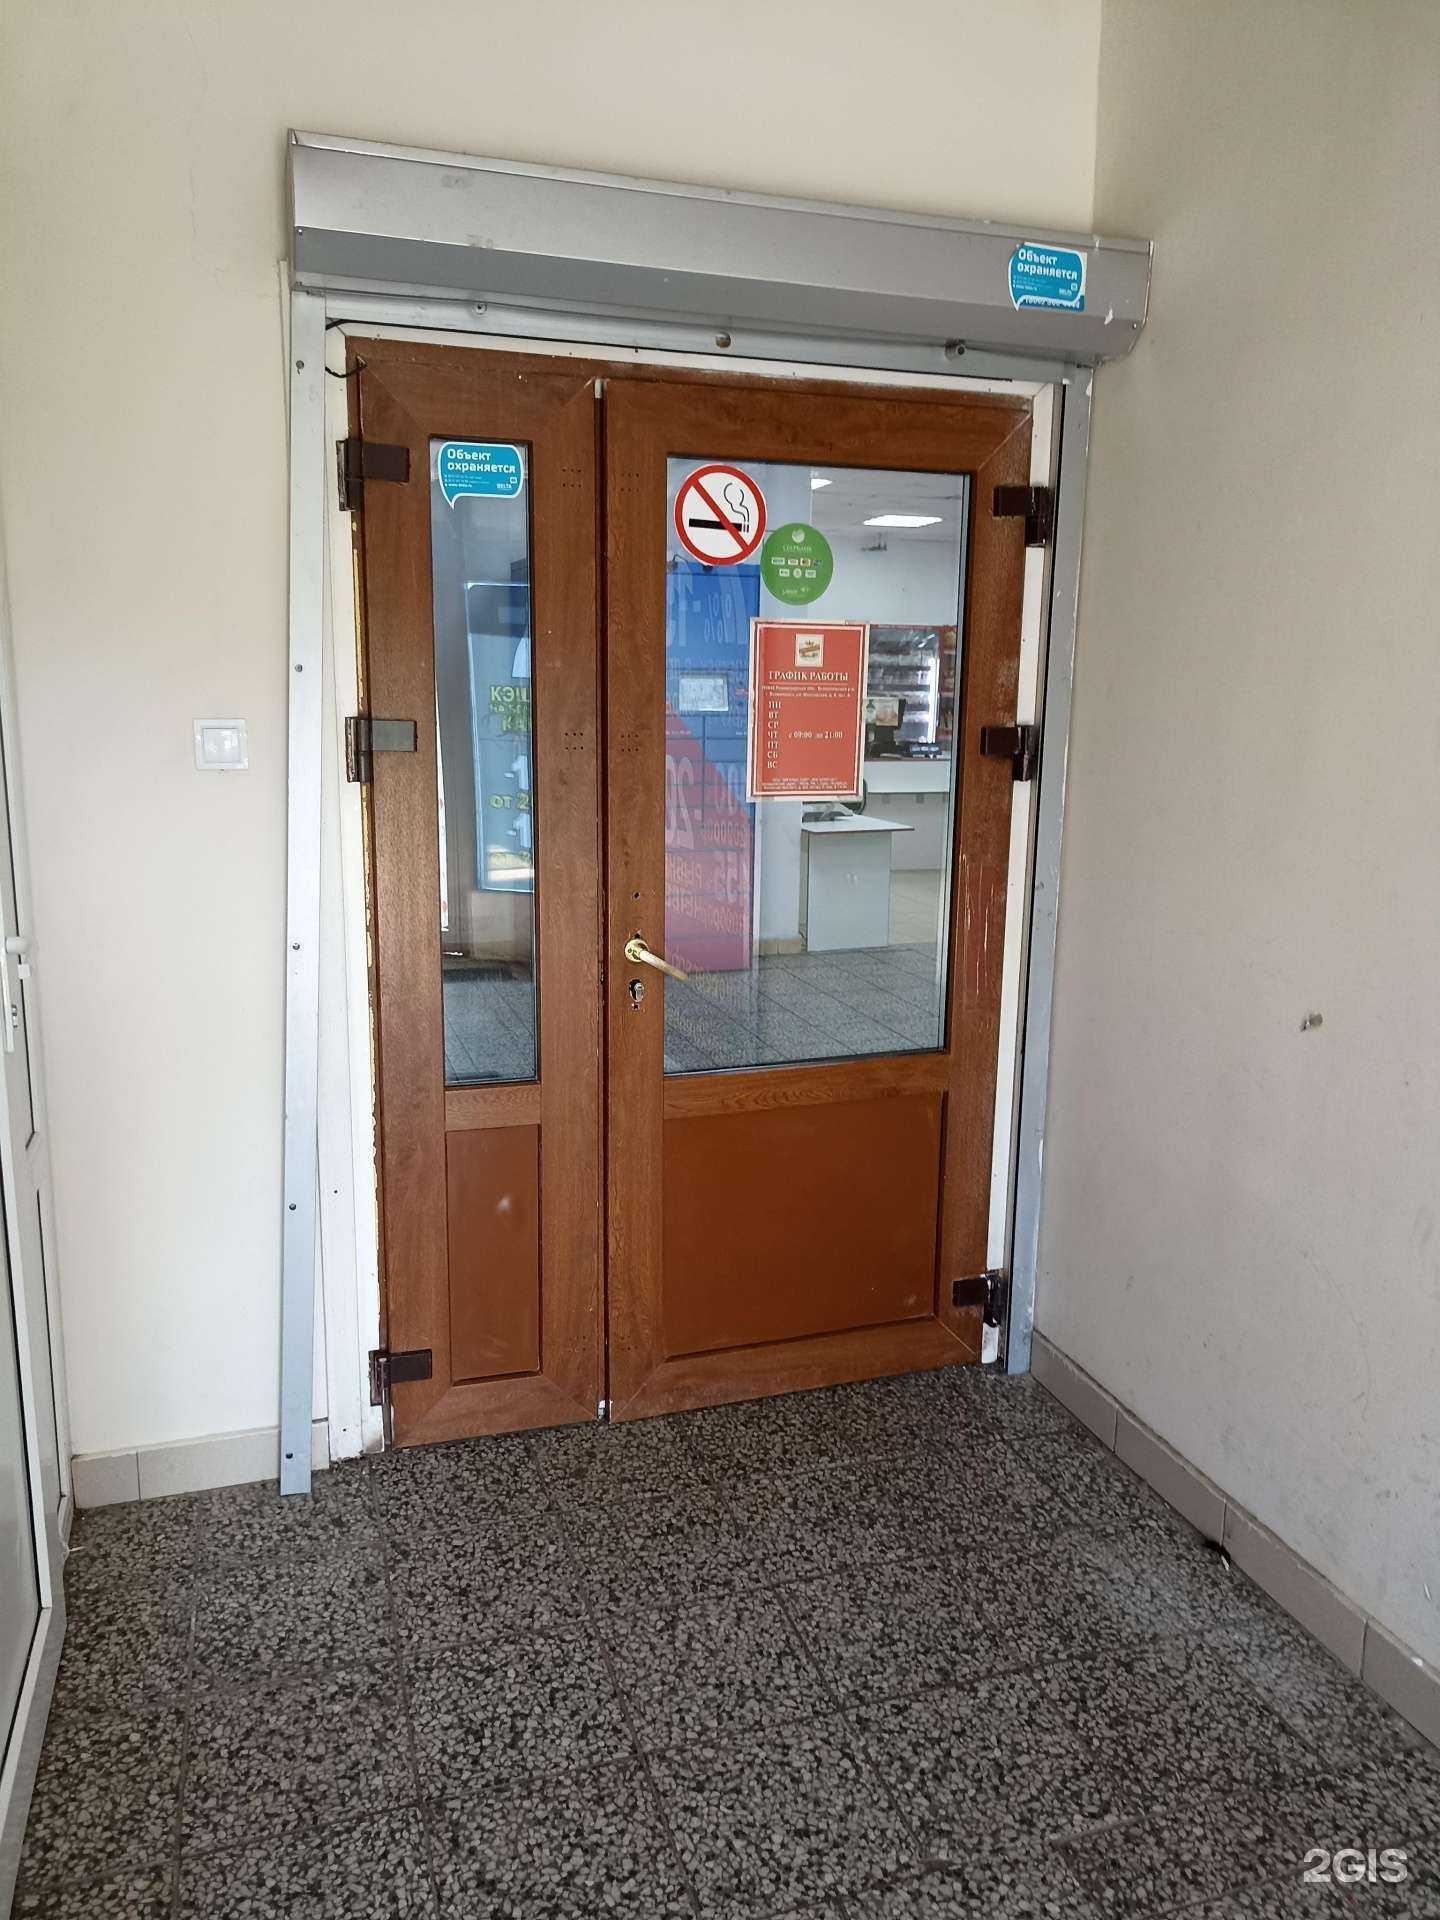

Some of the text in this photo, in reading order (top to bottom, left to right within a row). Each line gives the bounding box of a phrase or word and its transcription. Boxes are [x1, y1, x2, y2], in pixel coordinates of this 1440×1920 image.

[1018, 248, 1058, 266] Объект
[1017, 262, 1078, 281] охраняется
[447, 448, 492, 461] Объект
[447, 461, 516, 474] охраняется
[769, 670, 848, 681] ГРАФИК РАБОТЫ
[768, 700, 781, 709] ПН
[768, 711, 779, 720] ВТ
[767, 721, 779, 729] СР
[767, 730, 778, 739] ЧТ
[767, 741, 778, 749] ПТ
[767, 750, 778, 759] СБ
[767, 760, 777, 769] ВС
